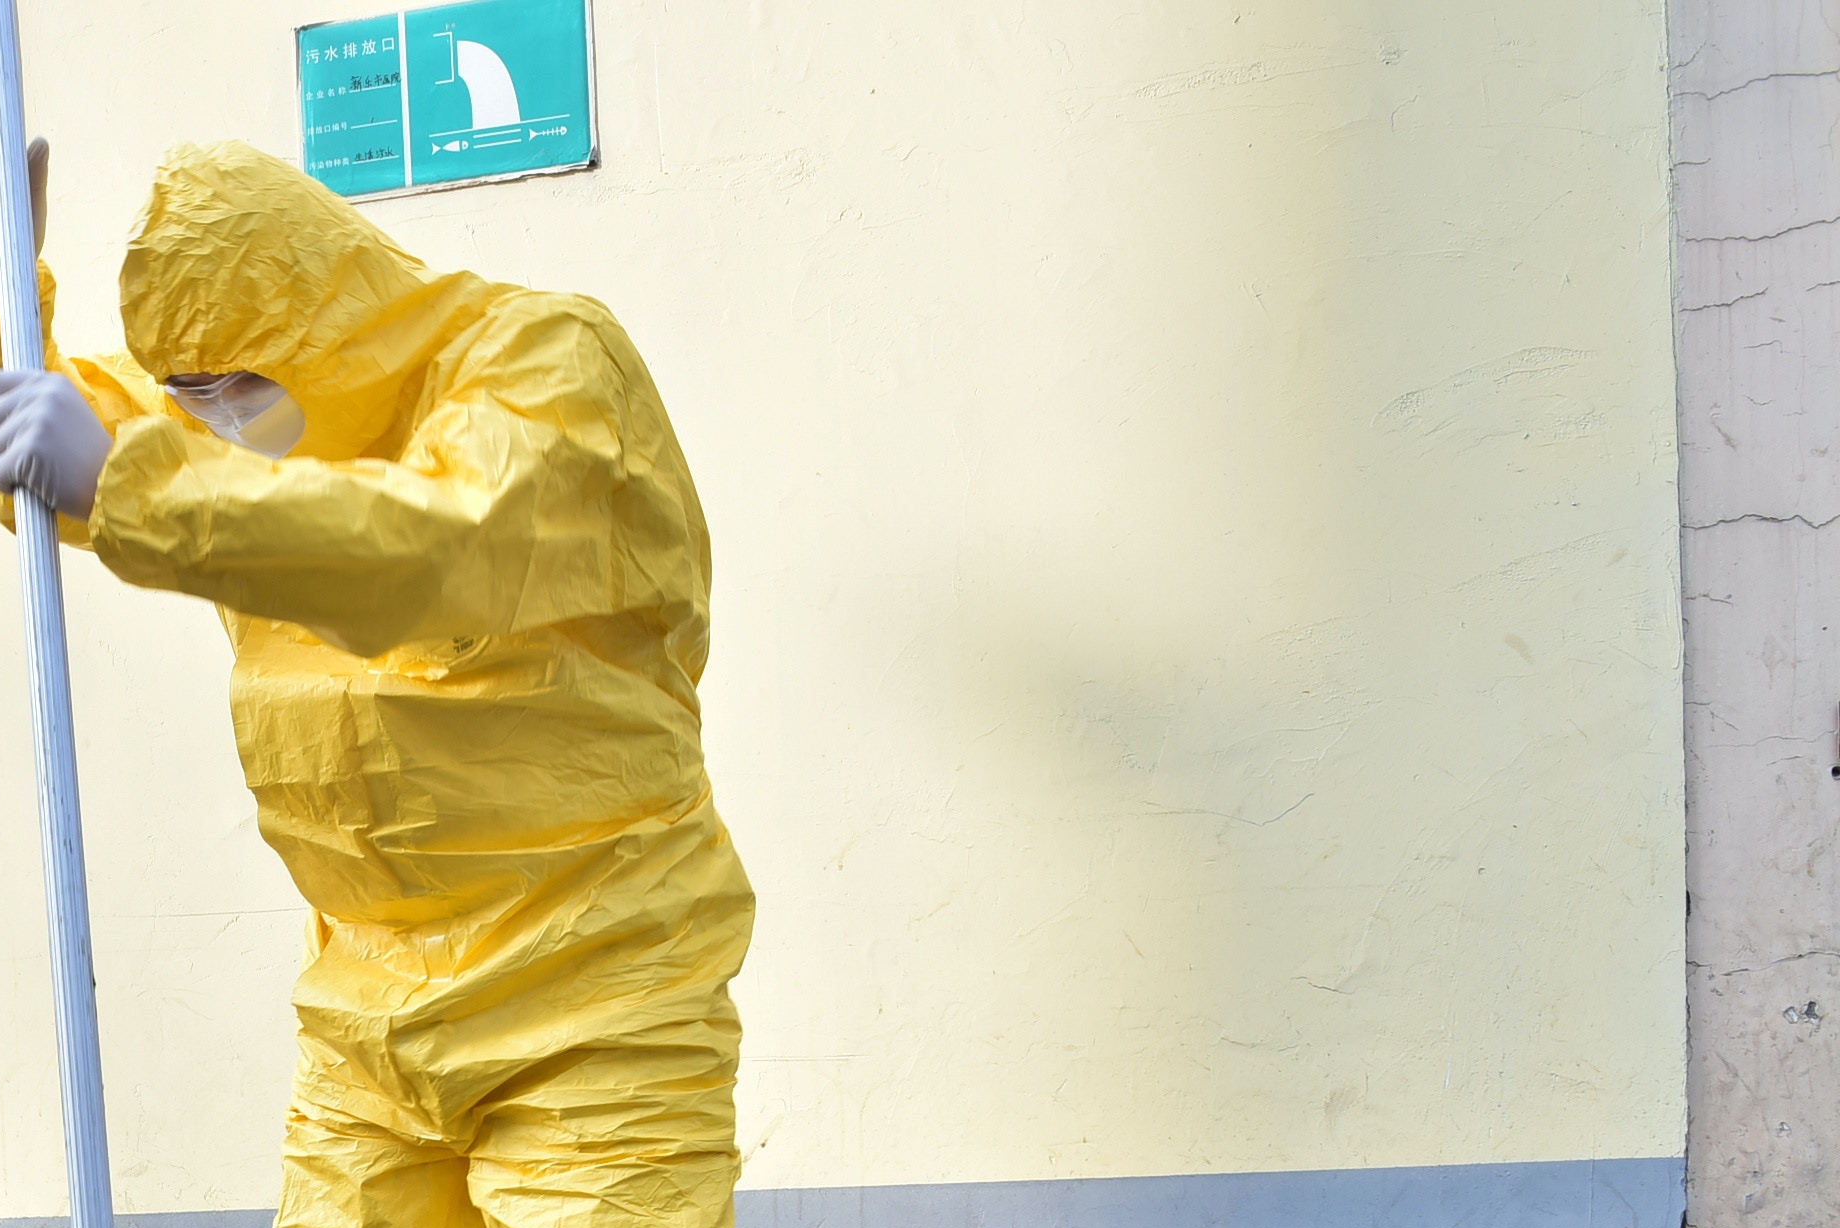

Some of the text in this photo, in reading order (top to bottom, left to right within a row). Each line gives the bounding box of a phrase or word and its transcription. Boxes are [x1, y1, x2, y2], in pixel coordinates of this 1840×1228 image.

[306, 37, 395, 64] 污水排放口
[306, 86, 347, 101] 企业名称
[307, 121, 348, 136] 排放口编号
